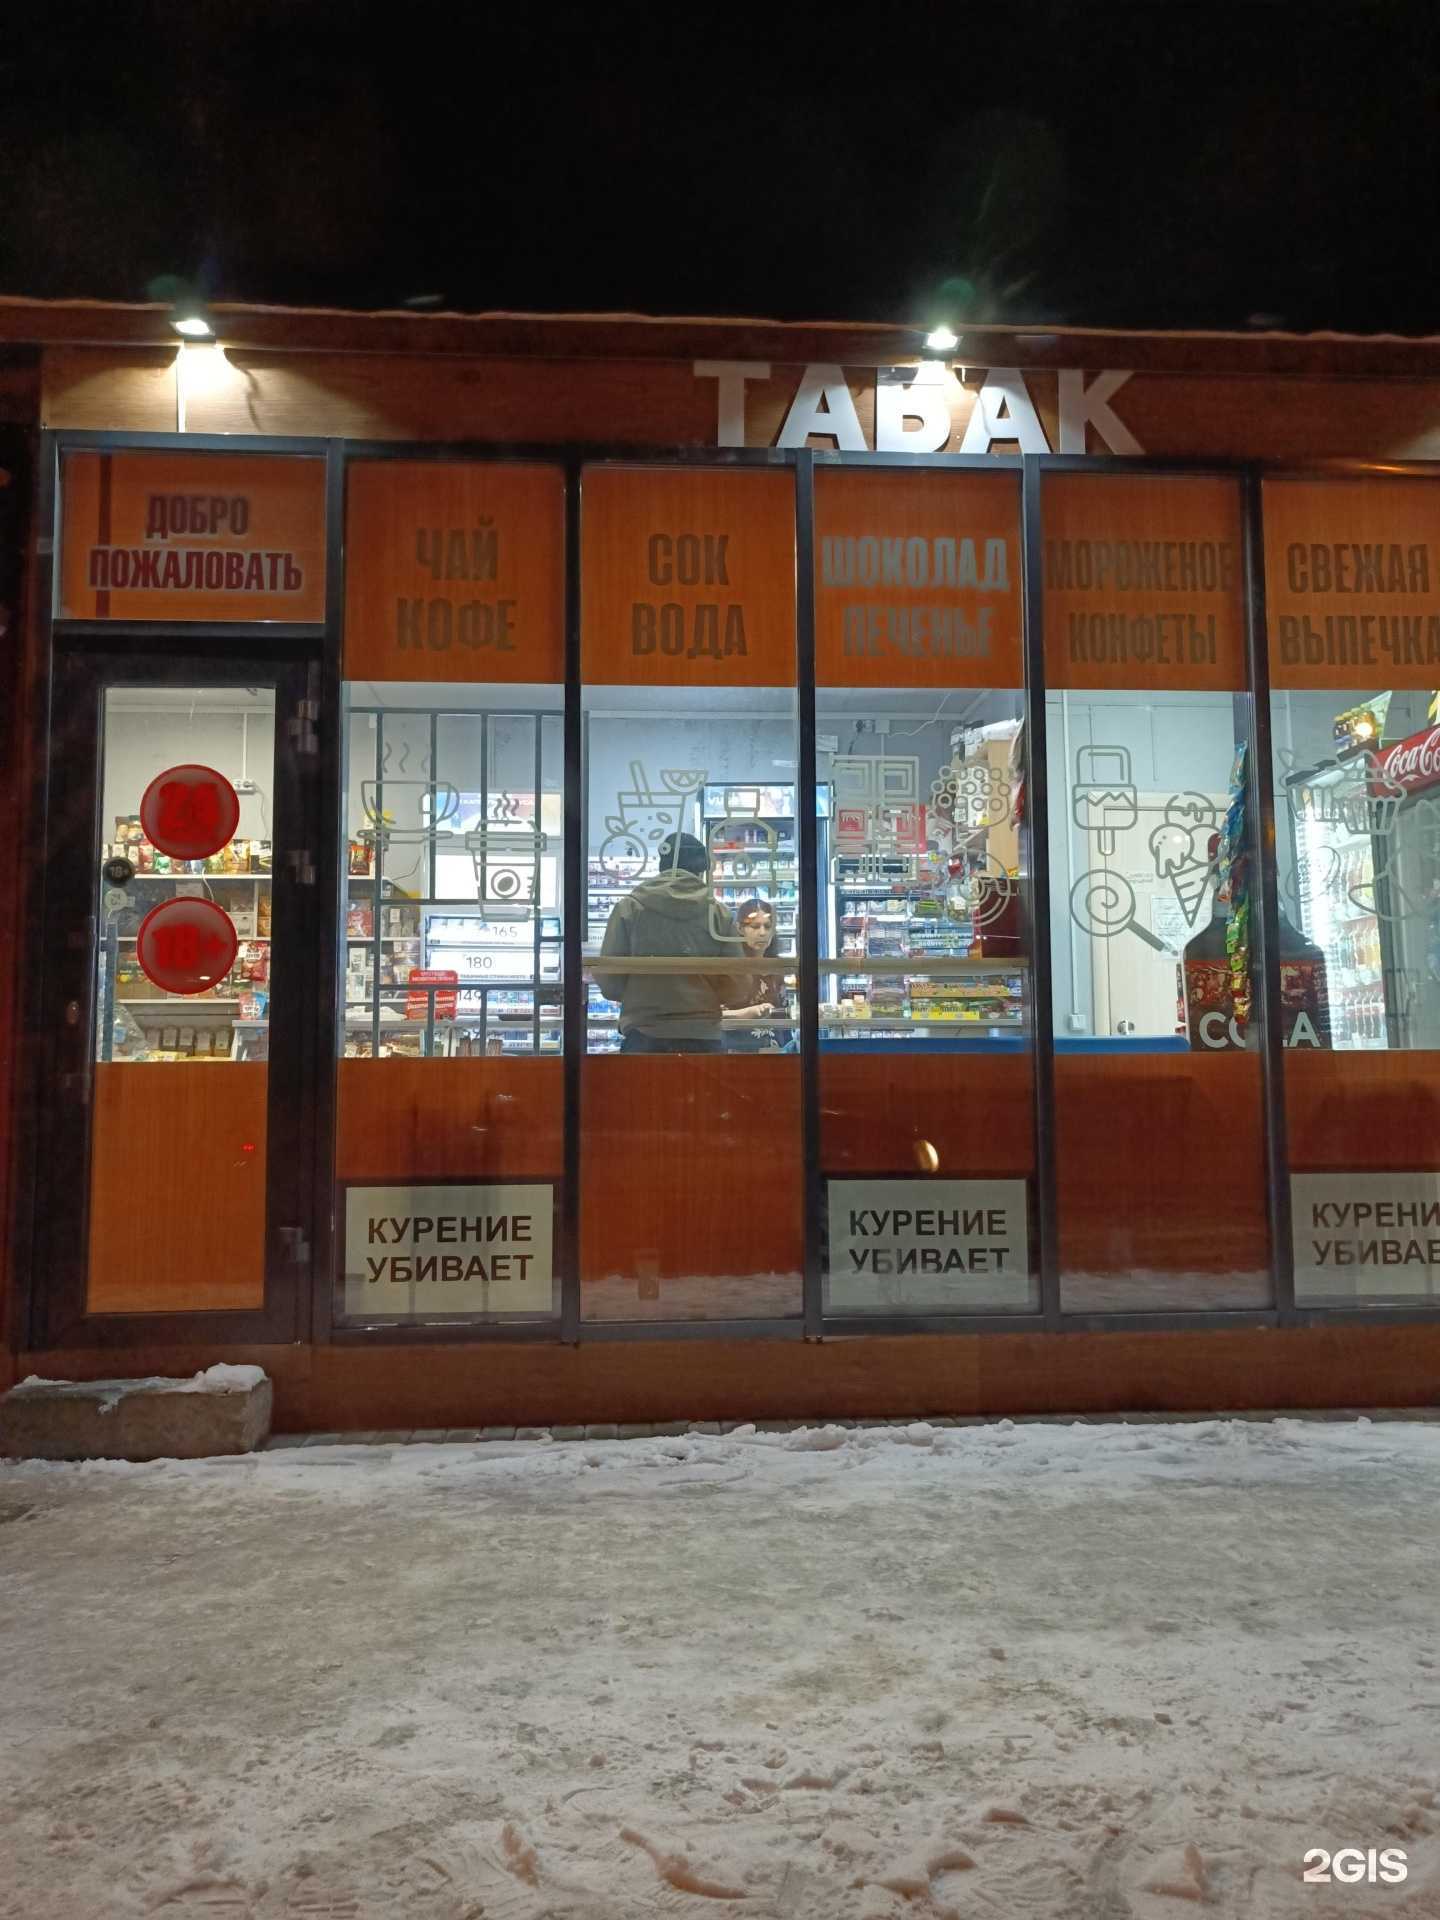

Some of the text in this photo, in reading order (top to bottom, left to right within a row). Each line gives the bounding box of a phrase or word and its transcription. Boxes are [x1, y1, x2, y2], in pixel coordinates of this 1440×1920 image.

[694, 360, 1146, 455] ТАБАК
[145, 495, 250, 539] ДОБРО
[89, 548, 303, 591] ПОЖАЛОВАТЬ
[416, 515, 498, 581] ЧАЙ
[648, 533, 730, 587] СОК
[821, 536, 1009, 592] ШОКОЛАД
[1045, 540, 1233, 592] МОРОЖЕНОЕ
[1287, 543, 1430, 594] СВЕЖАЯ
[397, 598, 517, 651] КОФЕ
[632, 603, 748, 660] ВОДА
[843, 606, 996, 658] ПЕЧЕНЬЕ
[1068, 612, 1217, 665] КОНФЕТЫ
[465, 956, 493, 969] 180
[367, 1215, 533, 1244] КУРЕНИЕ
[850, 1209, 1008, 1236] КУРЕНИЕ
[1312, 1202, 1440, 1228] КУРЕНИ
[366, 1254, 535, 1283] УБИВАЕТ
[848, 1248, 1010, 1275] УБИВАЕТ
